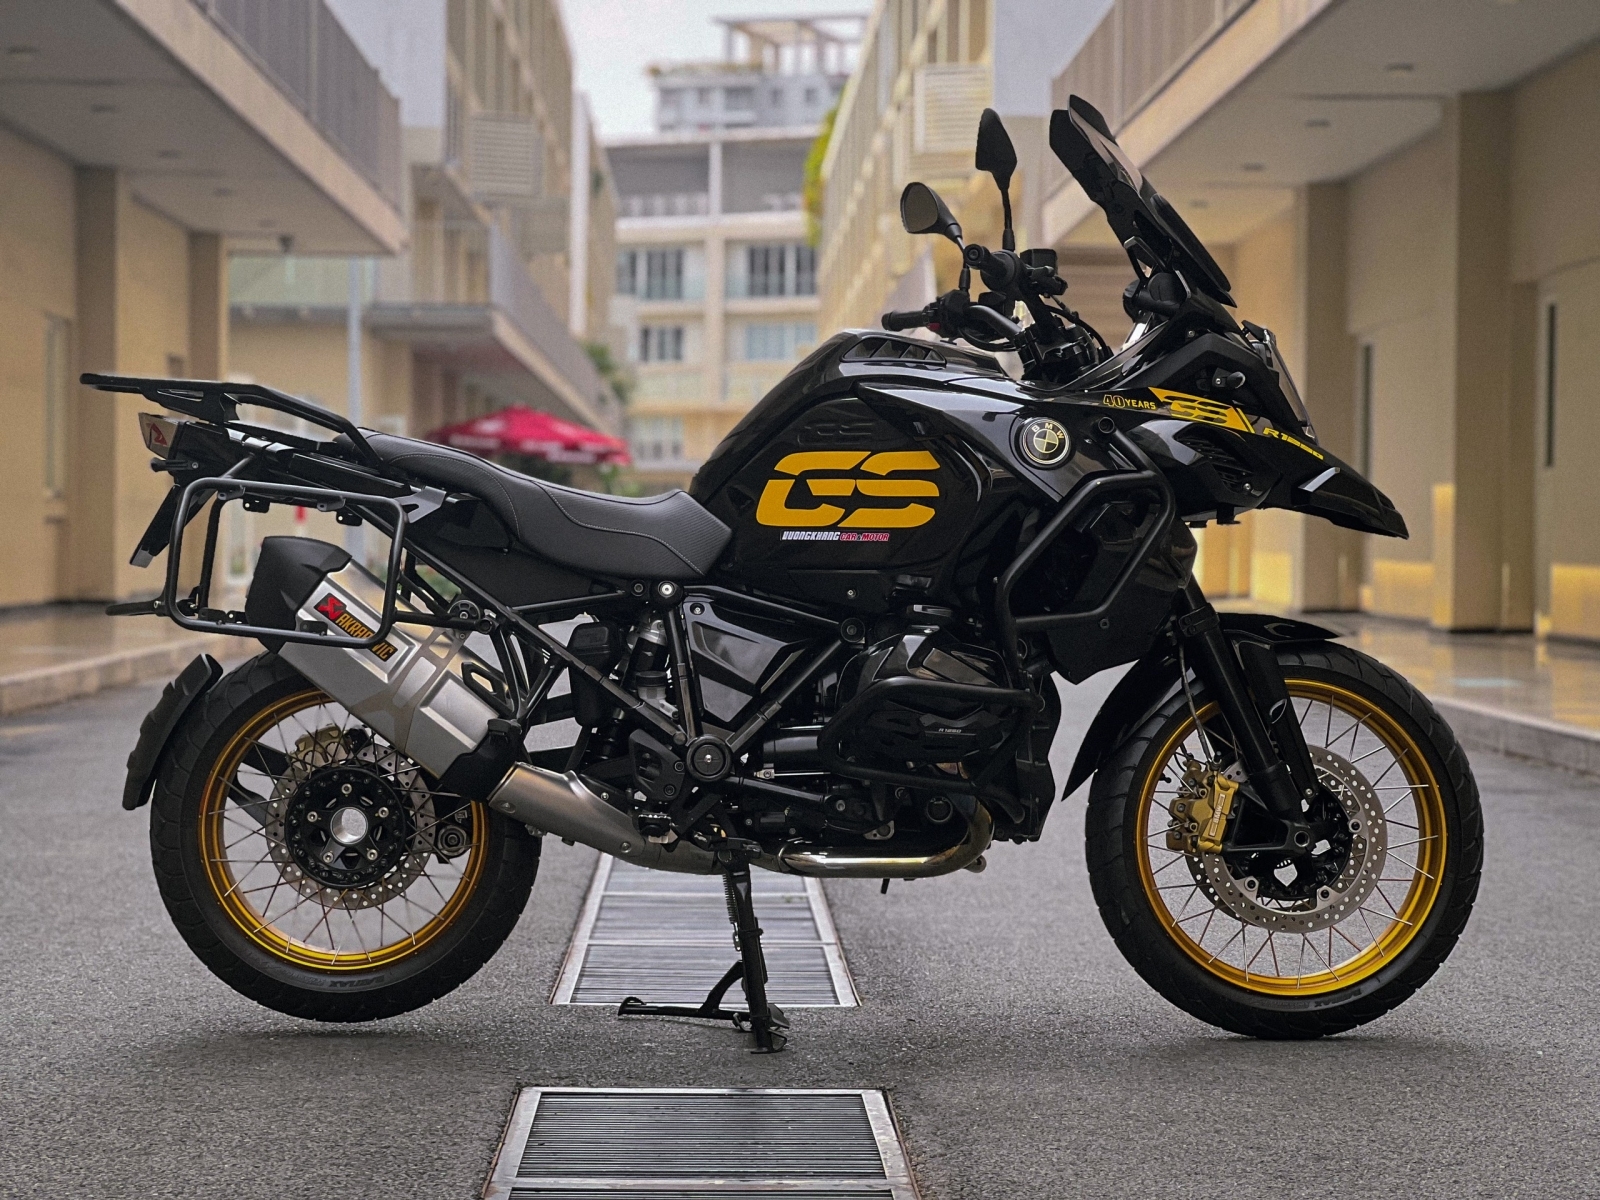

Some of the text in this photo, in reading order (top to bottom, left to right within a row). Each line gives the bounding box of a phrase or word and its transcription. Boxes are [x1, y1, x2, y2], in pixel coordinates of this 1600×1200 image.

[1103, 394, 1157, 410] 40 YEARS
[1031, 422, 1065, 439] BMW
[756, 450, 941, 528] GS
[336, 613, 395, 660] AKRAPVIČ
